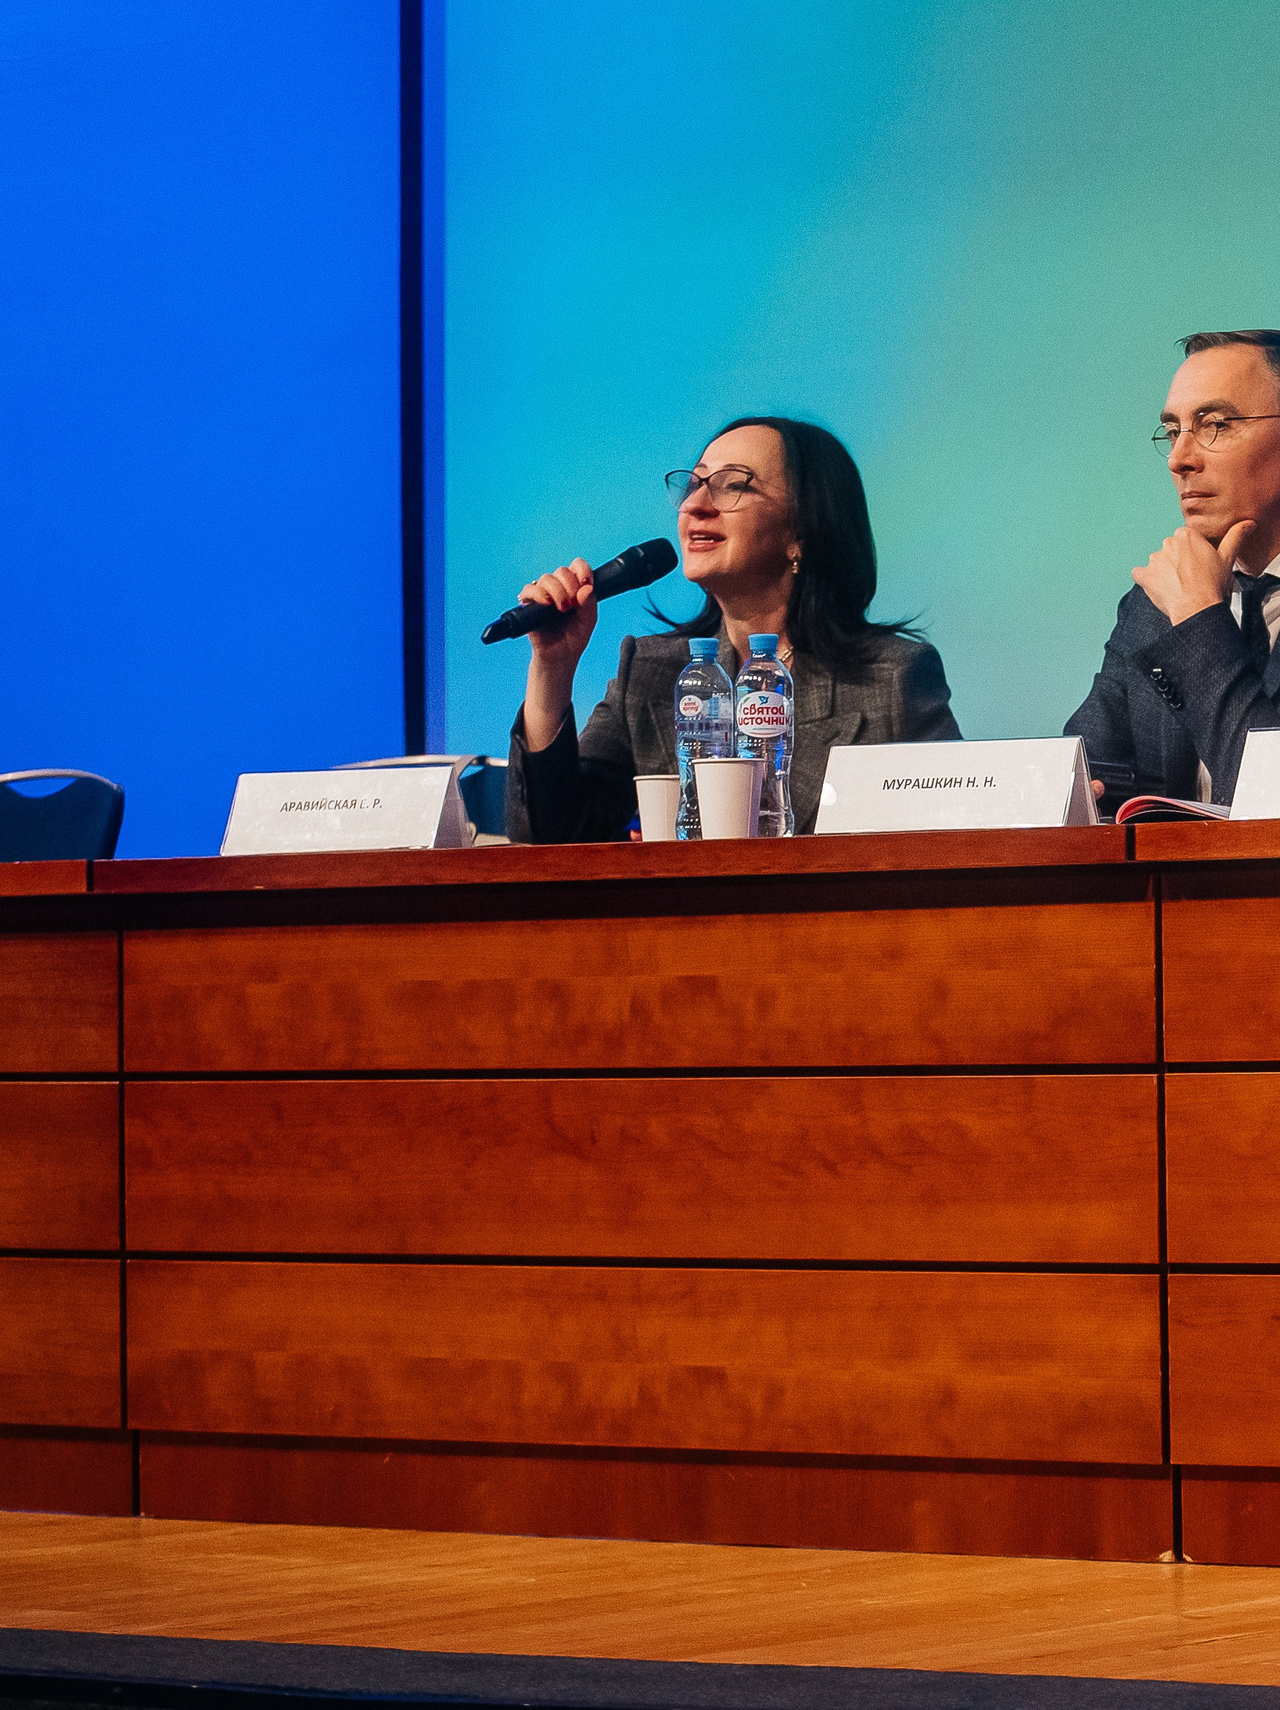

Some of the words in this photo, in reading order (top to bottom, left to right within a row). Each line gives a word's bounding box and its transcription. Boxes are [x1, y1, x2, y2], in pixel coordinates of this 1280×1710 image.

[882, 777, 963, 791] МУРАШКИН
[966, 776, 980, 789] Н.
[983, 776, 997, 789] Н.
[280, 797, 357, 813] АРАВИЙСКАЯ
[372, 798, 384, 810] Р.
